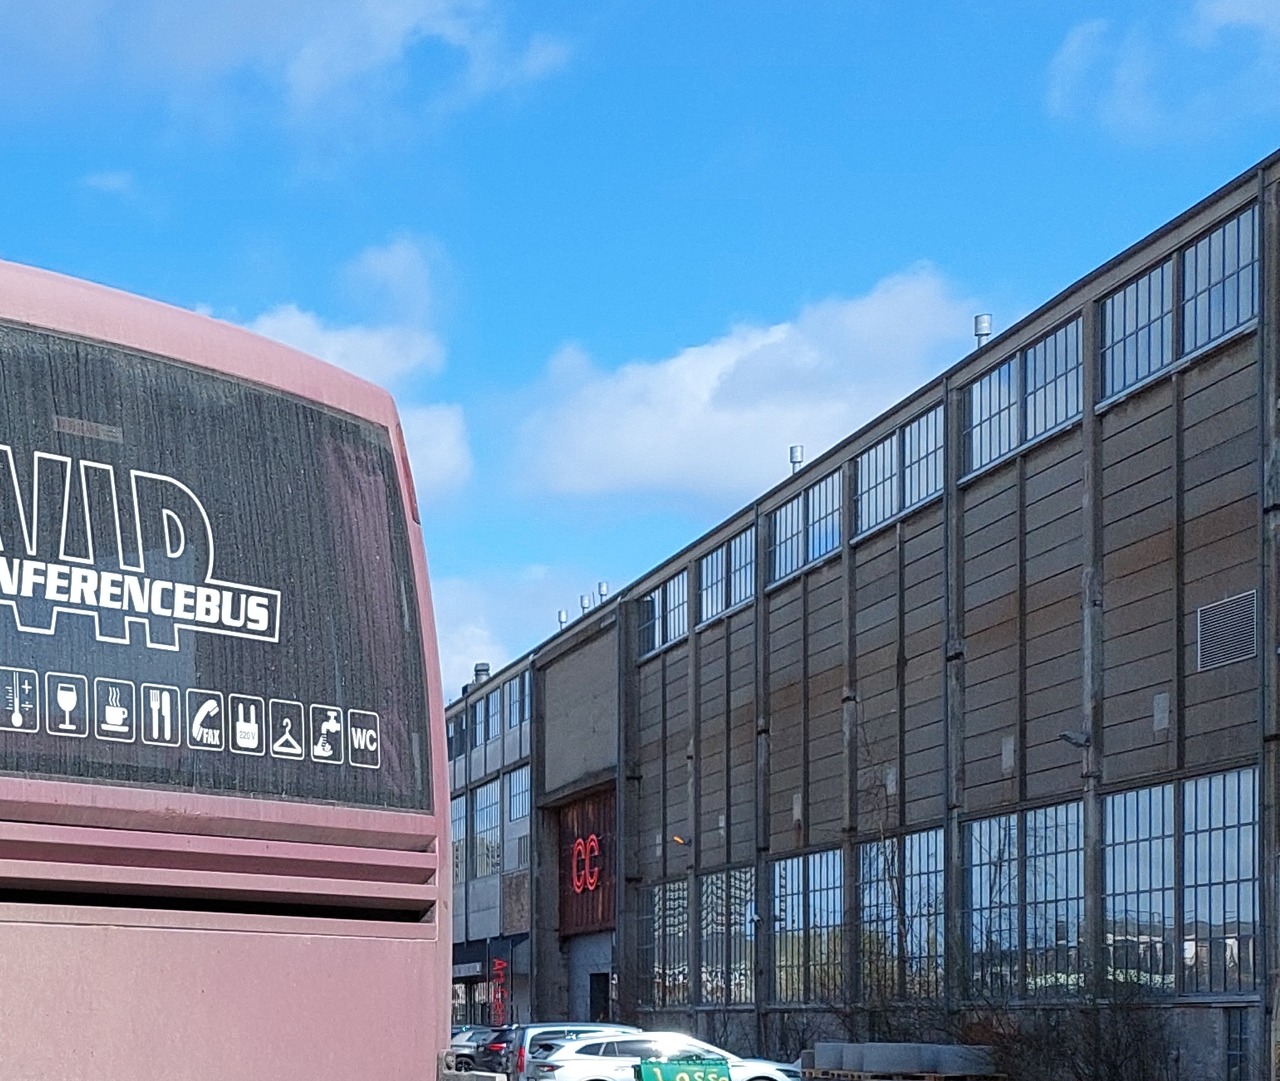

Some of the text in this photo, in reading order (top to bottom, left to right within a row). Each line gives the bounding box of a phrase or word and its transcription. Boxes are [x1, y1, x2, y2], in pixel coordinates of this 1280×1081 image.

[202, 727, 221, 746] FAX
[351, 726, 378, 751] WC
[571, 833, 600, 894] CC
